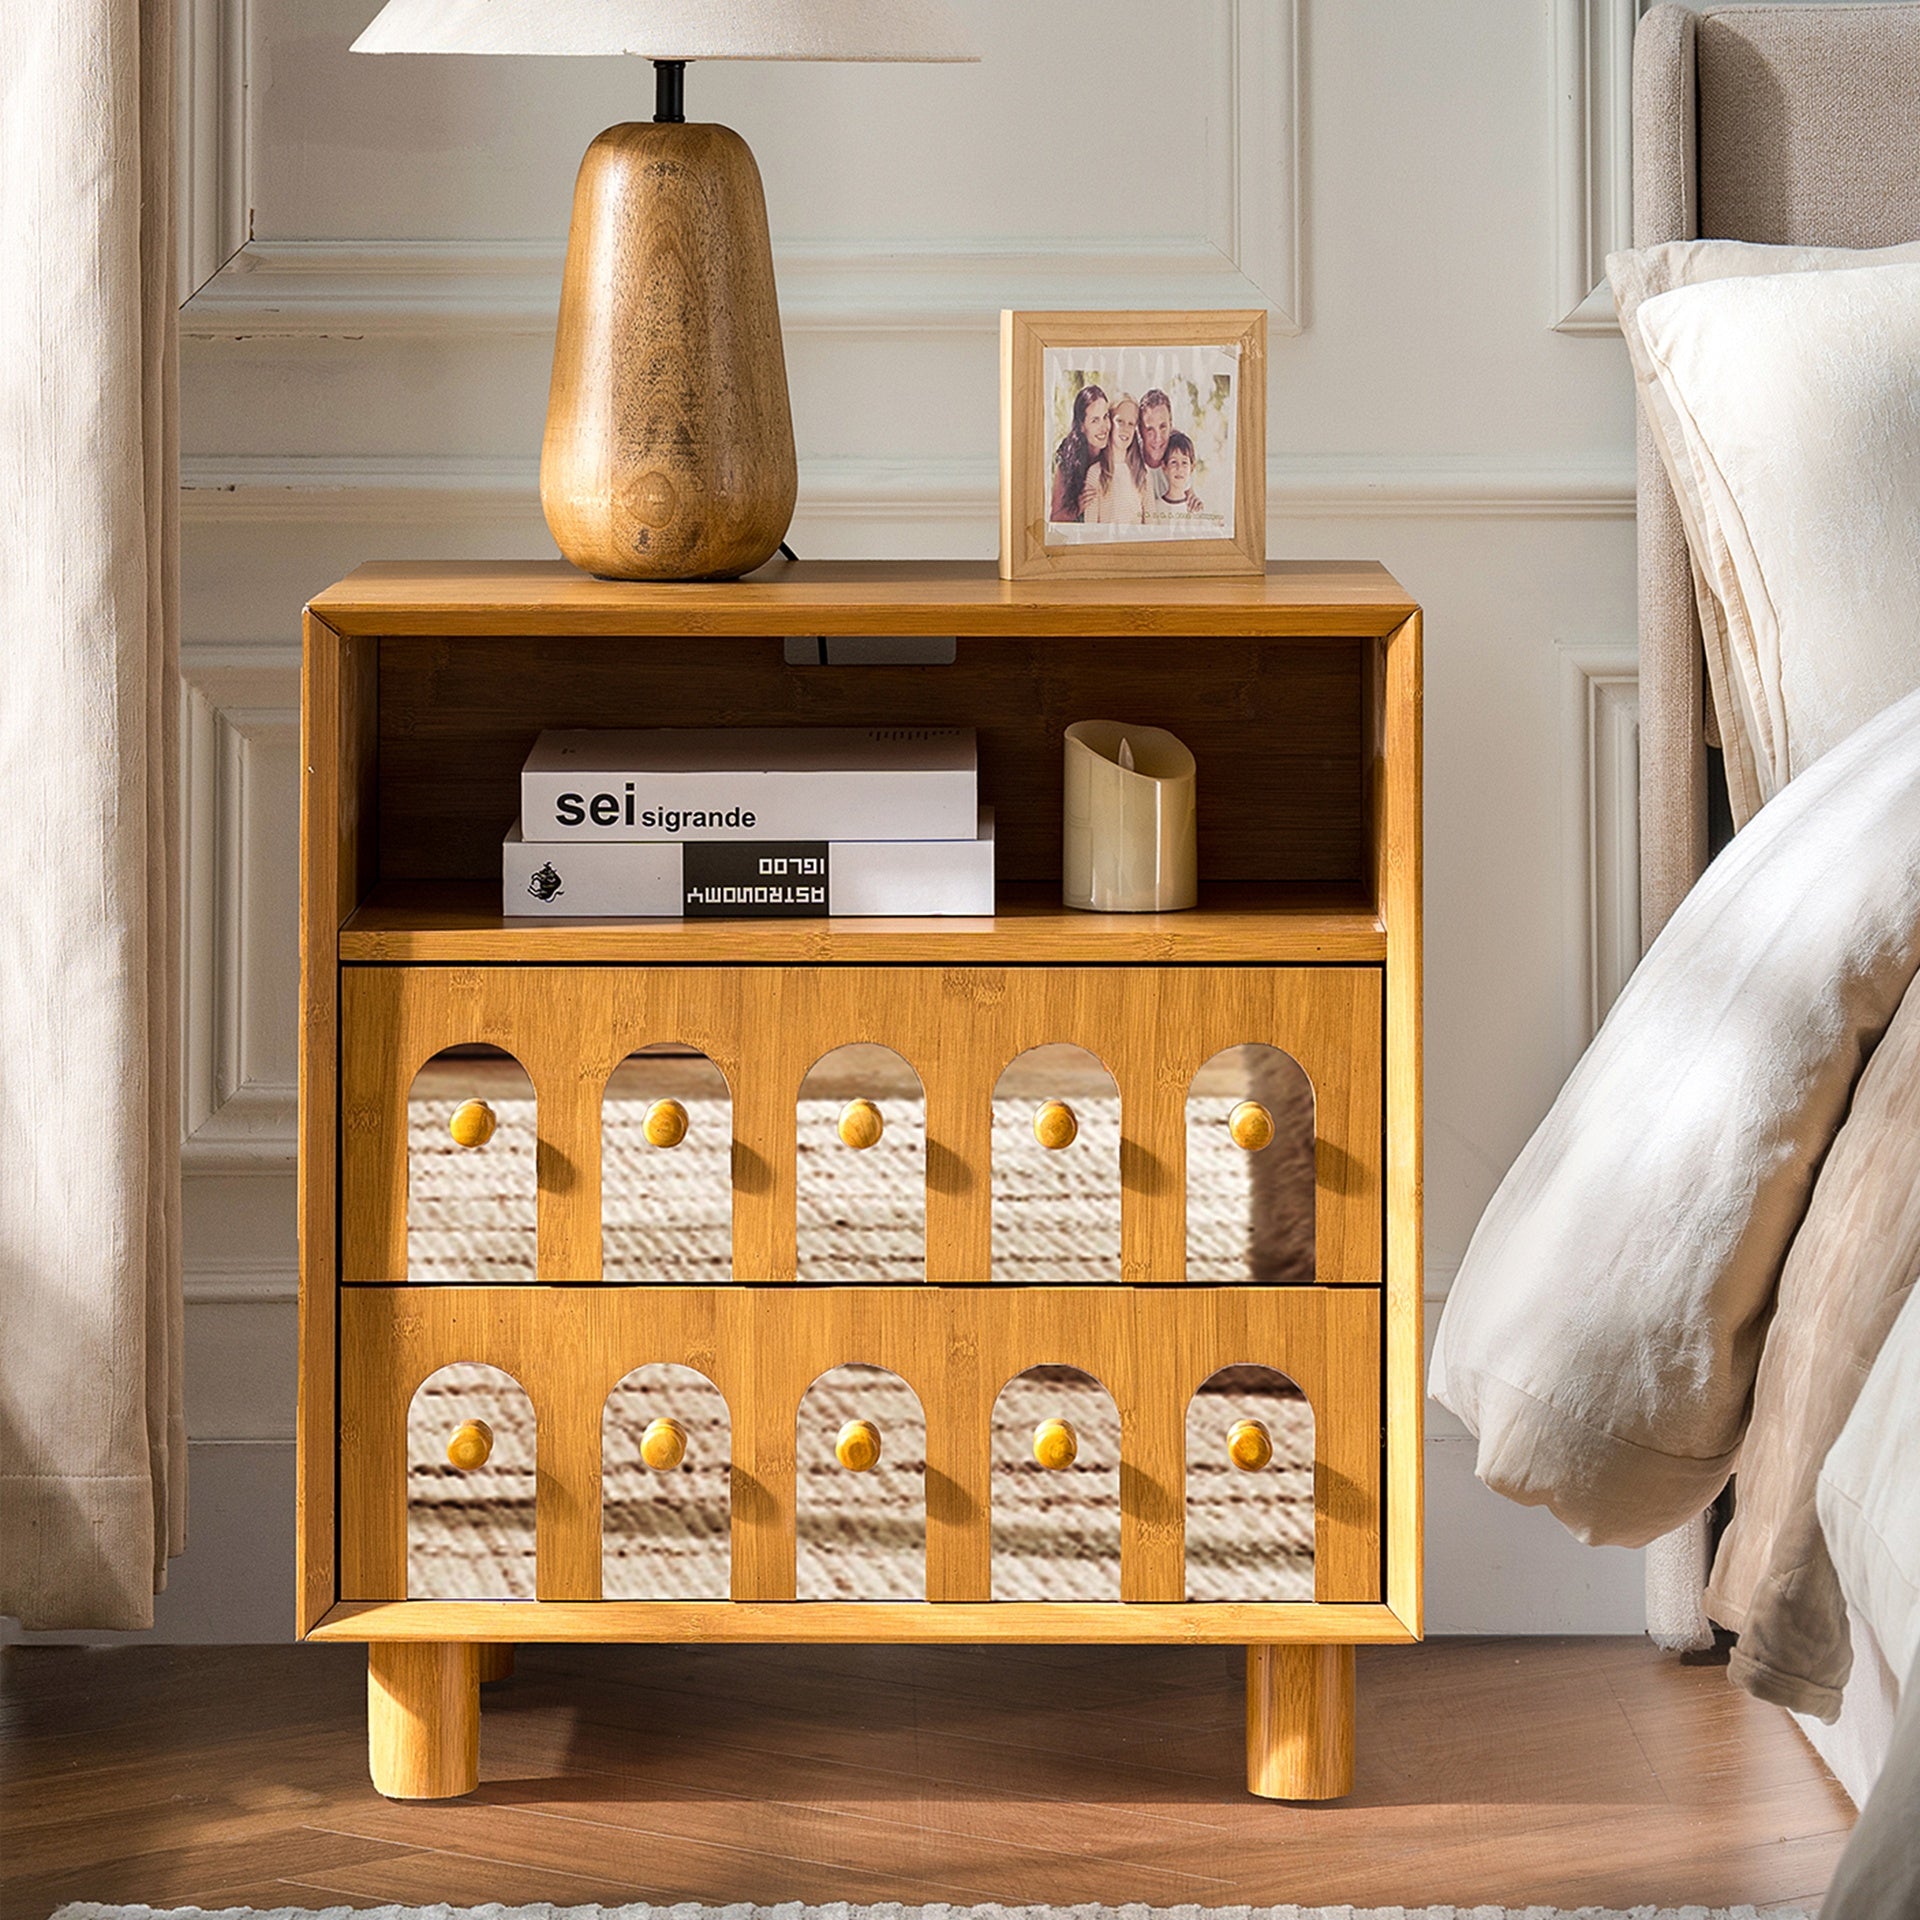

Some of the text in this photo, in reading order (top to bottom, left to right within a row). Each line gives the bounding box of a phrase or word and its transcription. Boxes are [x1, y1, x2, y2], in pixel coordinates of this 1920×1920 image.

[555, 782, 756, 832] sei sigrande
[759, 858, 825, 875] IGLOO
[687, 886, 825, 903] ASTRONOMY
